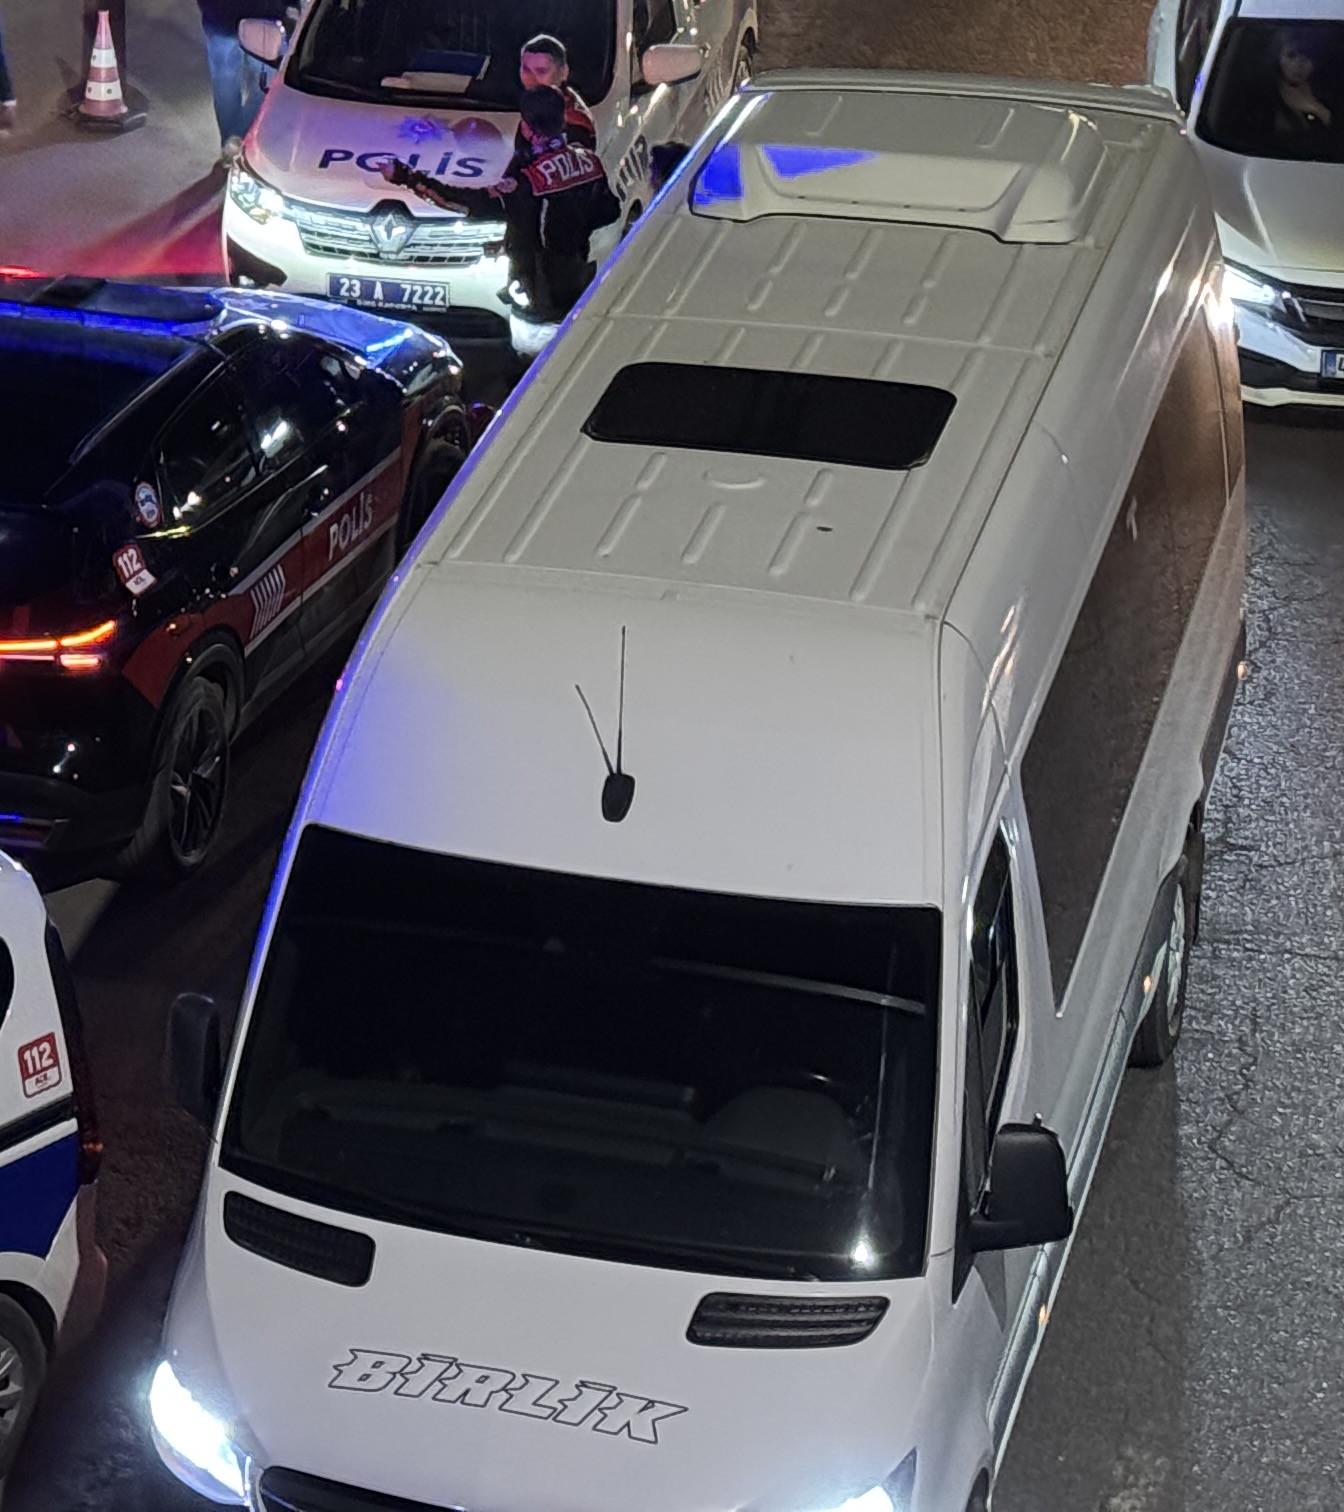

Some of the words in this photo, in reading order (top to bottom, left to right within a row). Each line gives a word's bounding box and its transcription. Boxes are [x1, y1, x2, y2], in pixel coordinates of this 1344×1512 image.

[339, 277, 362, 298] 23
[373, 281, 385, 300] A
[400, 283, 446, 306] 7222
[118, 548, 142, 579] 112
[23, 1041, 54, 1075] 112
[327, 1348, 690, 1445] BİRLİK
